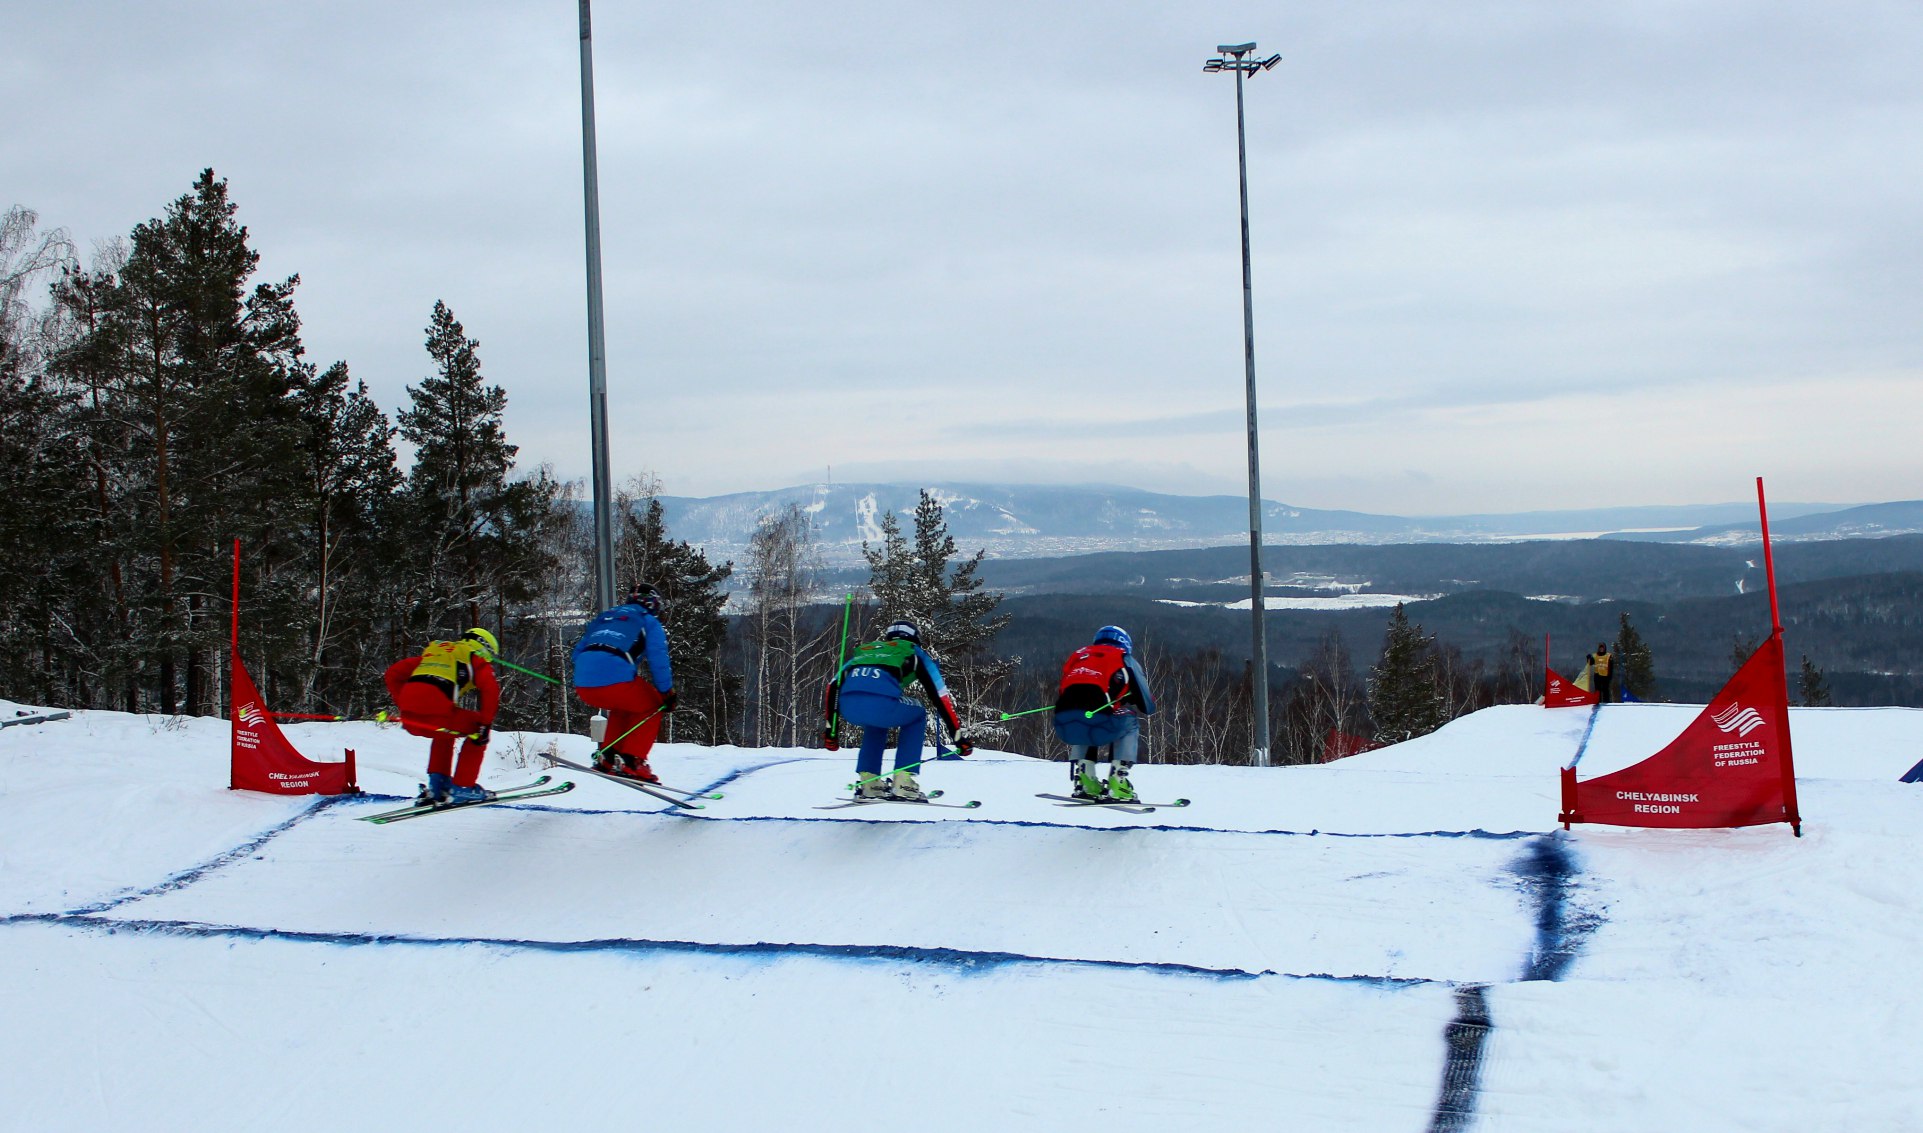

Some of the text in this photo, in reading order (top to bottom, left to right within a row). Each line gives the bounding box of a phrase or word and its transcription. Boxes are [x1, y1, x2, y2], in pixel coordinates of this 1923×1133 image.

[851, 667, 881, 679] RUS
[236, 729, 258, 738] ESTYLE
[236, 736, 260, 744] FRATION
[1713, 741, 1760, 752] FREESTYLE
[1714, 748, 1765, 759] FEDERATION
[1727, 757, 1758, 766] RUSSIA
[280, 780, 309, 788] REGION
[1616, 791, 1699, 803] CHELYABINSK
[1634, 804, 1680, 814] REGION
